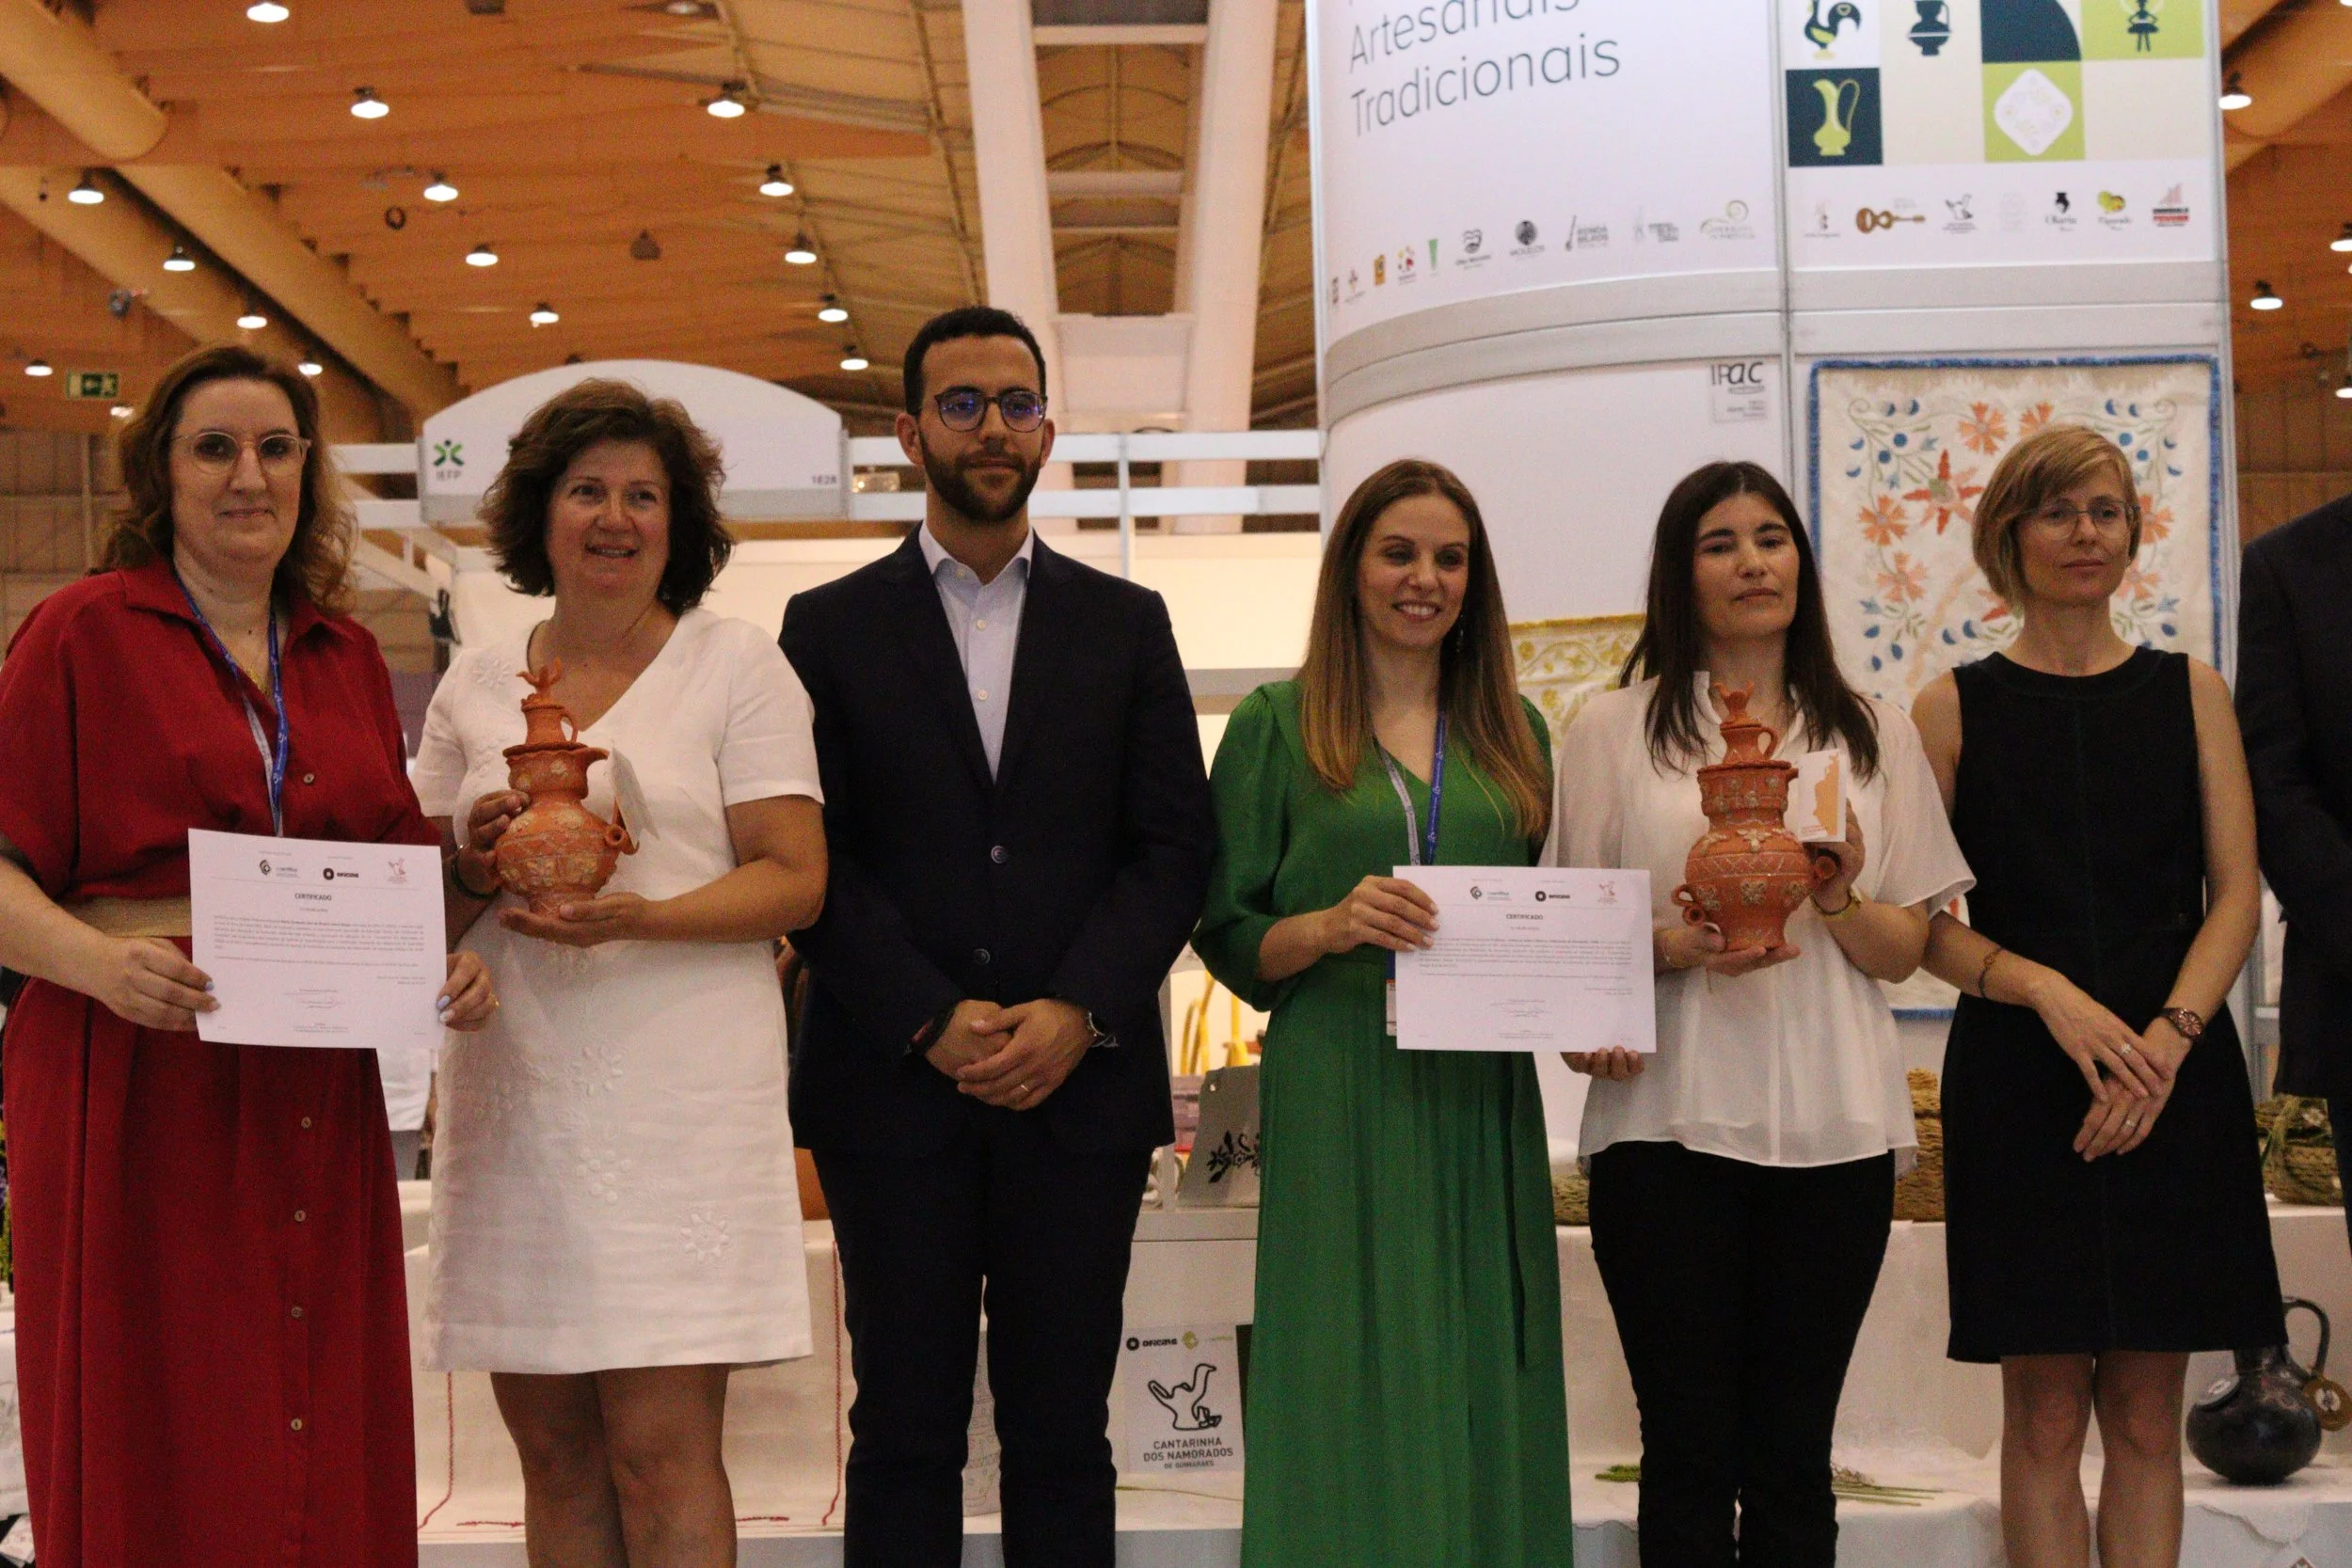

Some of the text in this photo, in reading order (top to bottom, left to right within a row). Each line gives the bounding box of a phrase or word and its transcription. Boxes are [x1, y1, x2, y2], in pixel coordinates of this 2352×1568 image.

[1349, 0, 1579, 73] Artesana
[1351, 34, 1620, 136] Tradicionais
[294, 893, 332, 901] CERTIFICADO
[1153, 1437, 1222, 1449] CANTARINHA
[1143, 1448, 1233, 1462] DOS NAMORADOS
